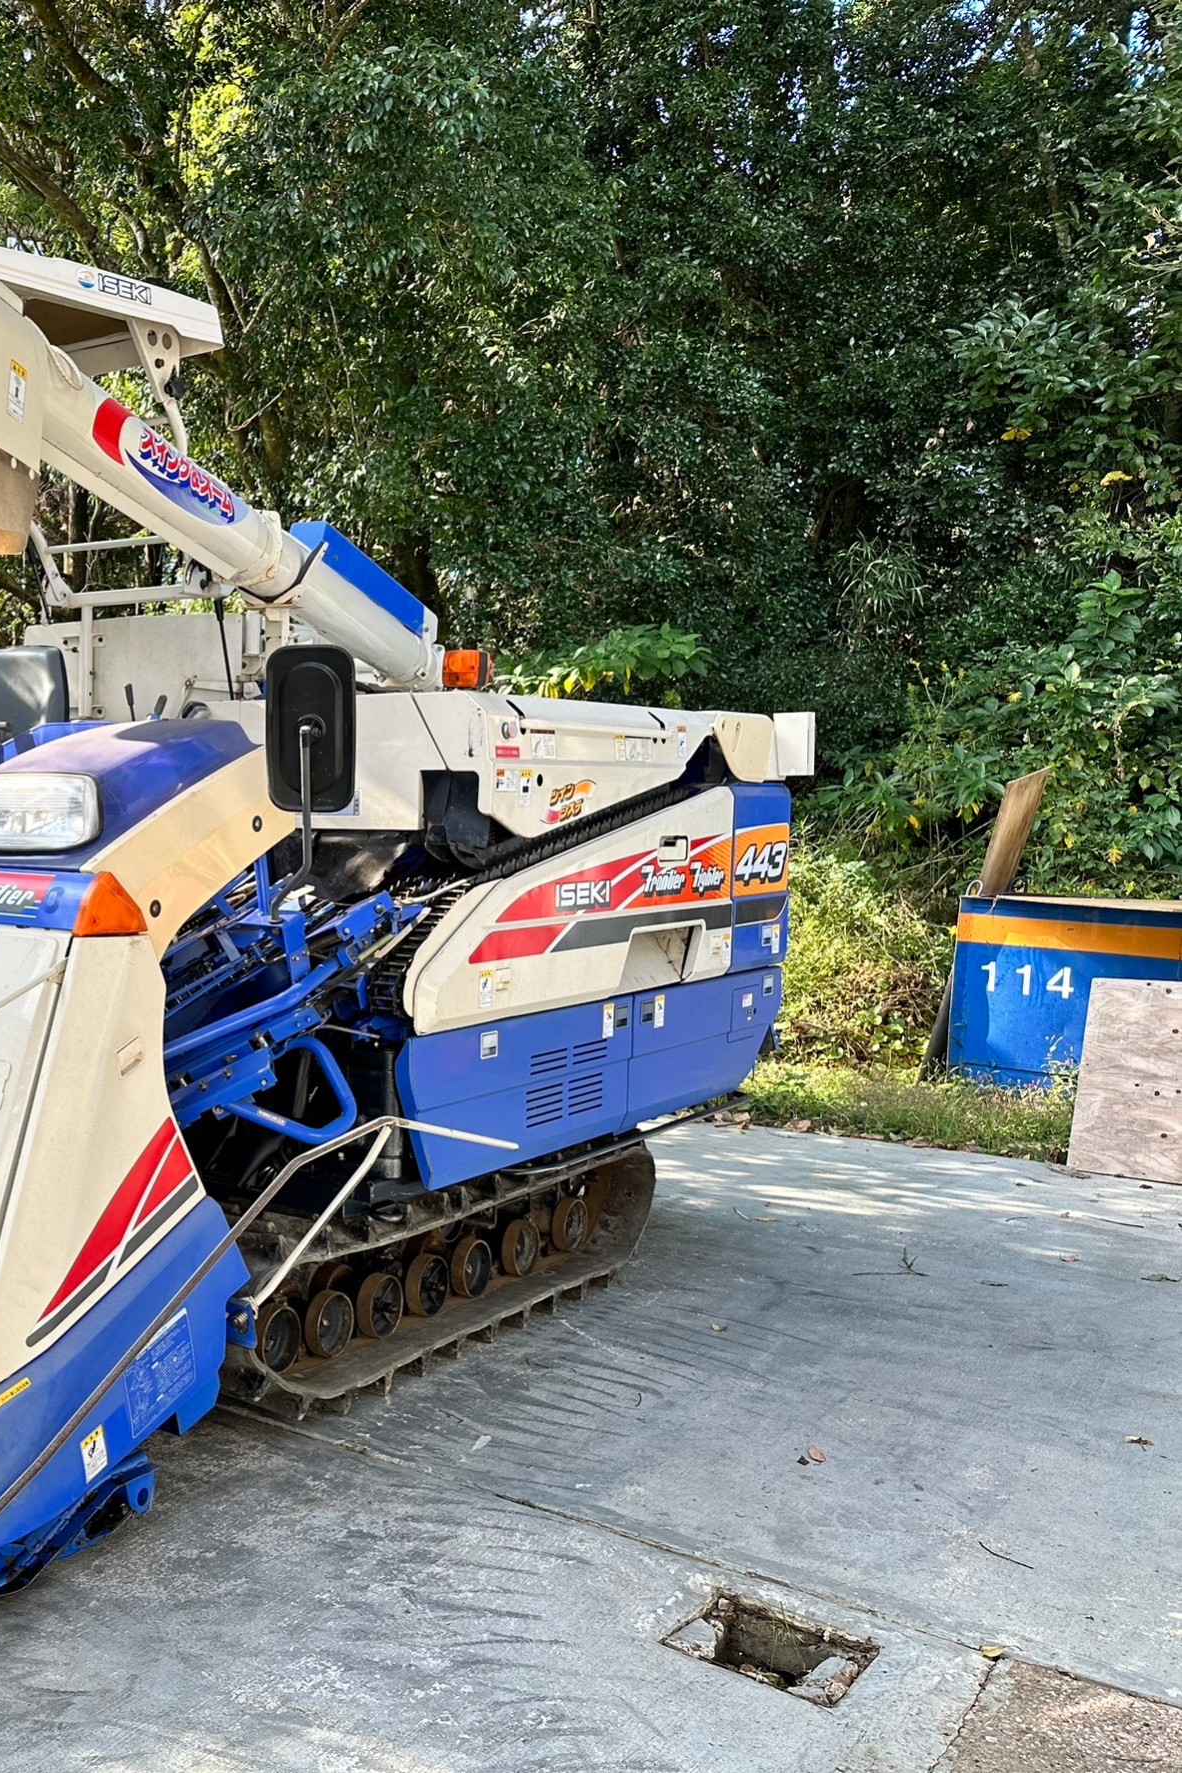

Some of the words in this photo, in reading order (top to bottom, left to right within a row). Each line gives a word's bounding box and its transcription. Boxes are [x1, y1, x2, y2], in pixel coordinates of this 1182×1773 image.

[98, 273, 151, 305] ISEKI
[734, 841, 787, 884] 443
[555, 880, 610, 908] ISEKI
[641, 864, 686, 895] Frontier
[690, 861, 725, 893] Fighter
[981, 961, 1075, 999] 114
